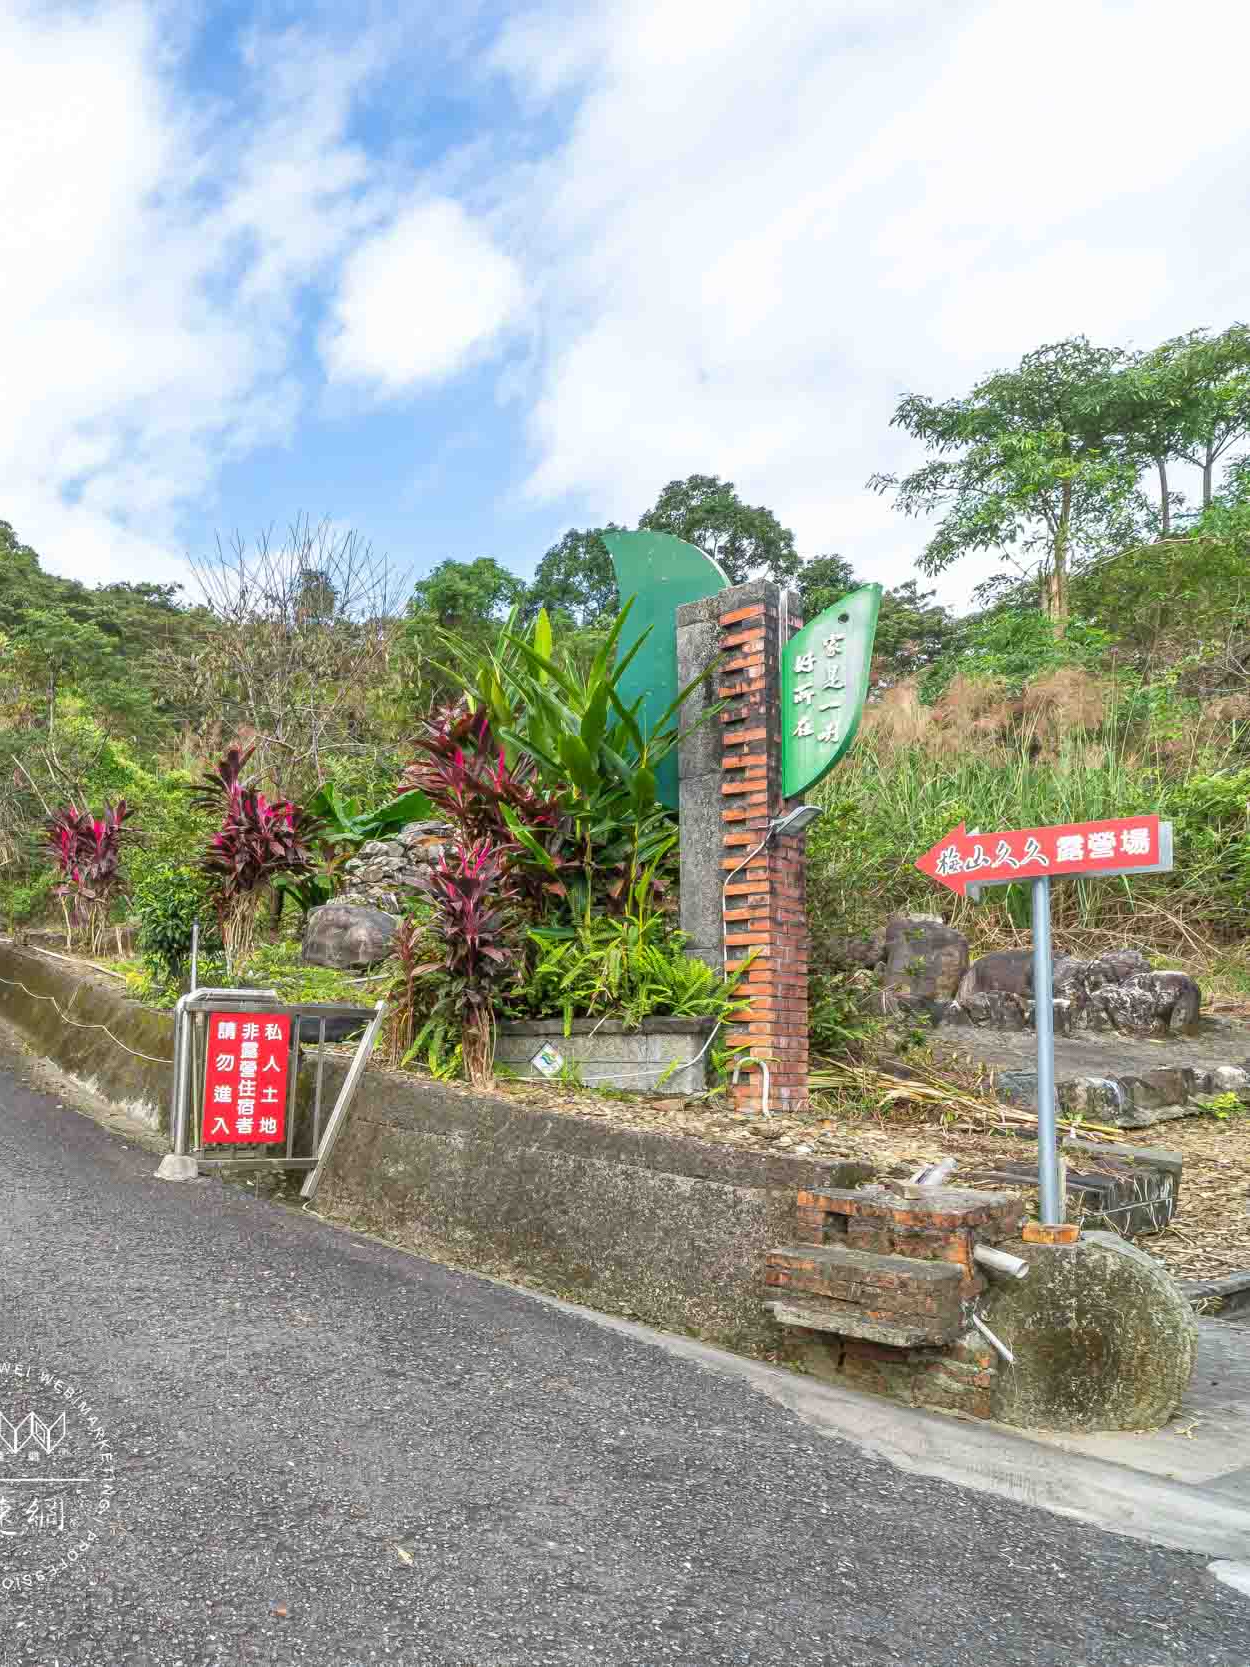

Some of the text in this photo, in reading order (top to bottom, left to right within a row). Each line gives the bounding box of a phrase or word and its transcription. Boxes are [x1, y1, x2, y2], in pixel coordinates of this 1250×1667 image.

[210, 1022, 237, 1135] 請勿進入
[235, 1022, 261, 1135] 非露營住宿者
[258, 1022, 283, 1135] 私人土地
